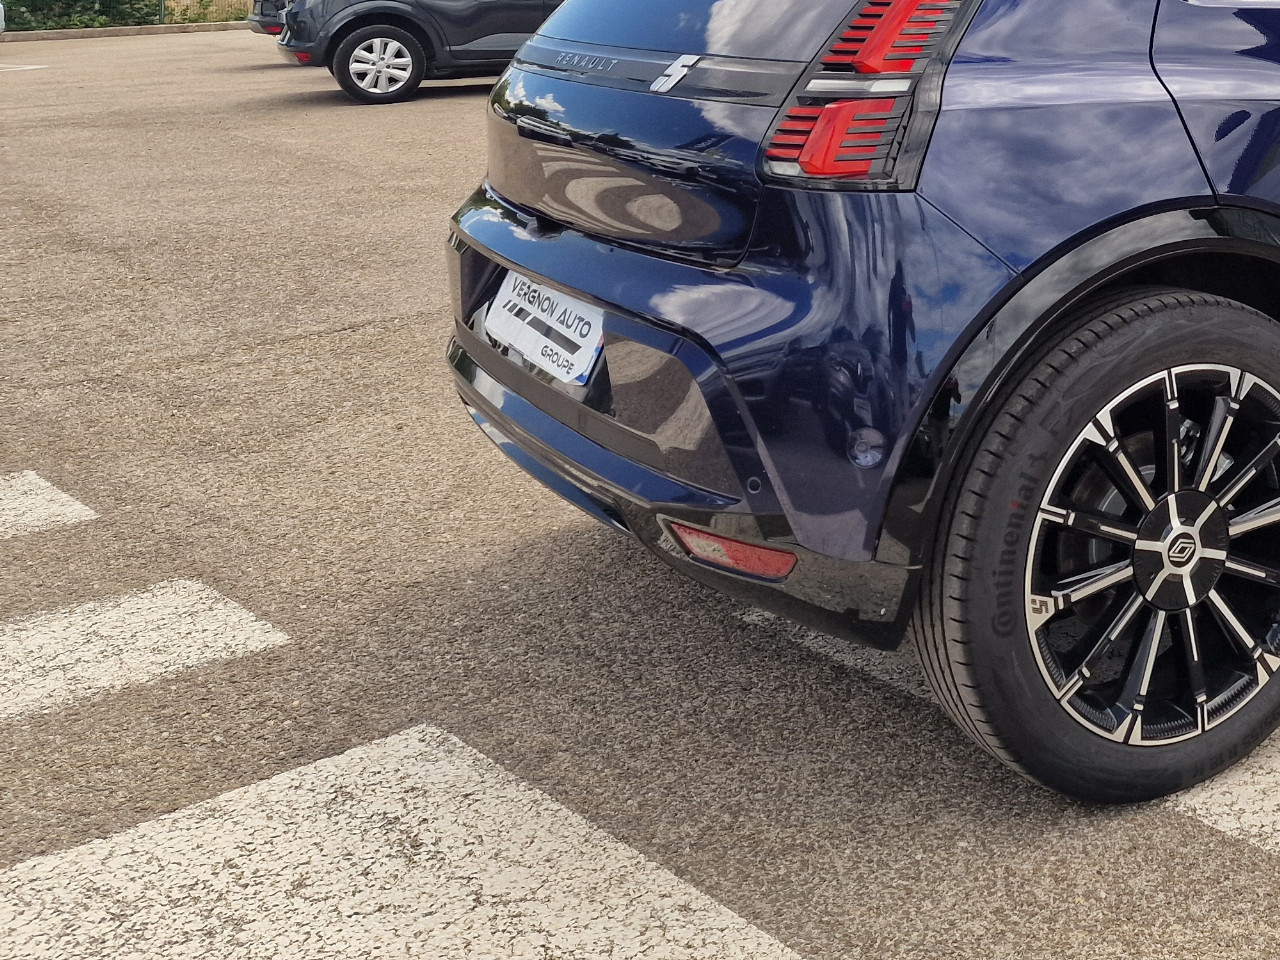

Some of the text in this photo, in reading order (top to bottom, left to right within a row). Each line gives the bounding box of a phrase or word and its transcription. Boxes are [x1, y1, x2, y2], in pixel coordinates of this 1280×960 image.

[555, 52, 619, 71] RENAULT
[511, 276, 592, 339] VERGNON AUTO
[541, 345, 575, 375] GROUPE
